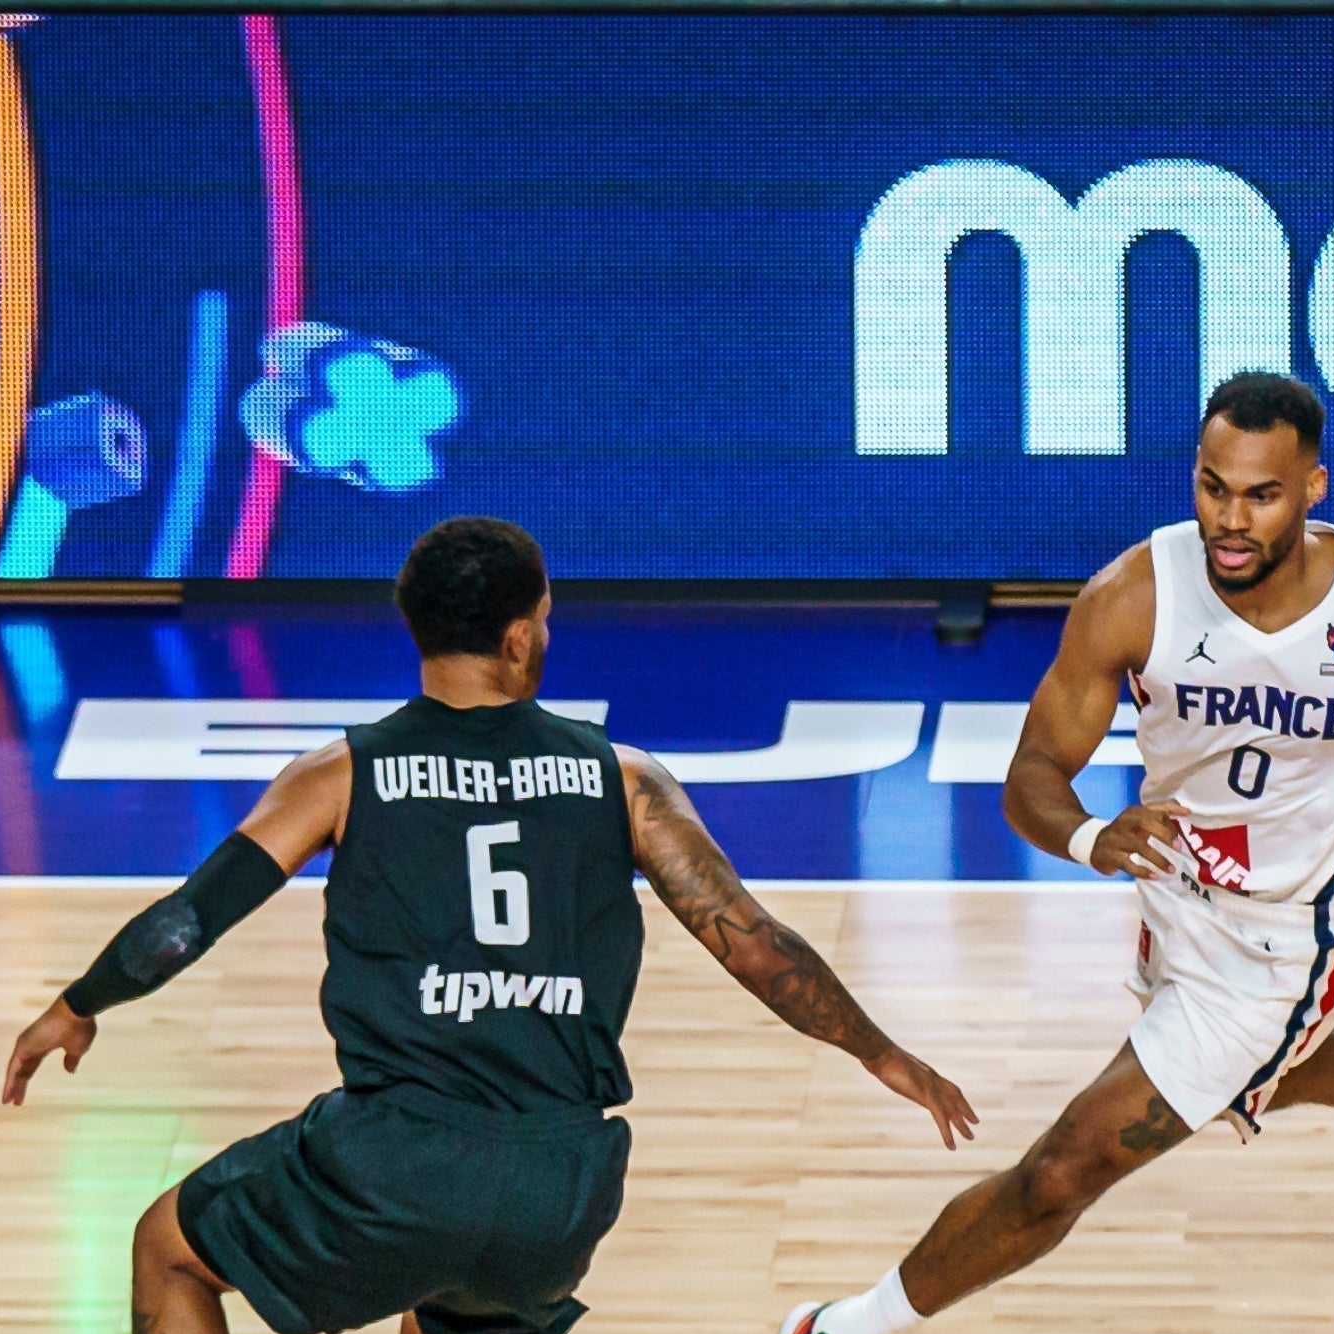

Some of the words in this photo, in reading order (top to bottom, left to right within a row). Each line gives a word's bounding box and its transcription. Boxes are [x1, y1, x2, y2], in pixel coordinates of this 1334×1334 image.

[373, 755, 604, 803] WEILER-BABB
[1227, 745, 1271, 800] 0
[466, 820, 530, 946] 6
[418, 963, 583, 1022] tipwin
